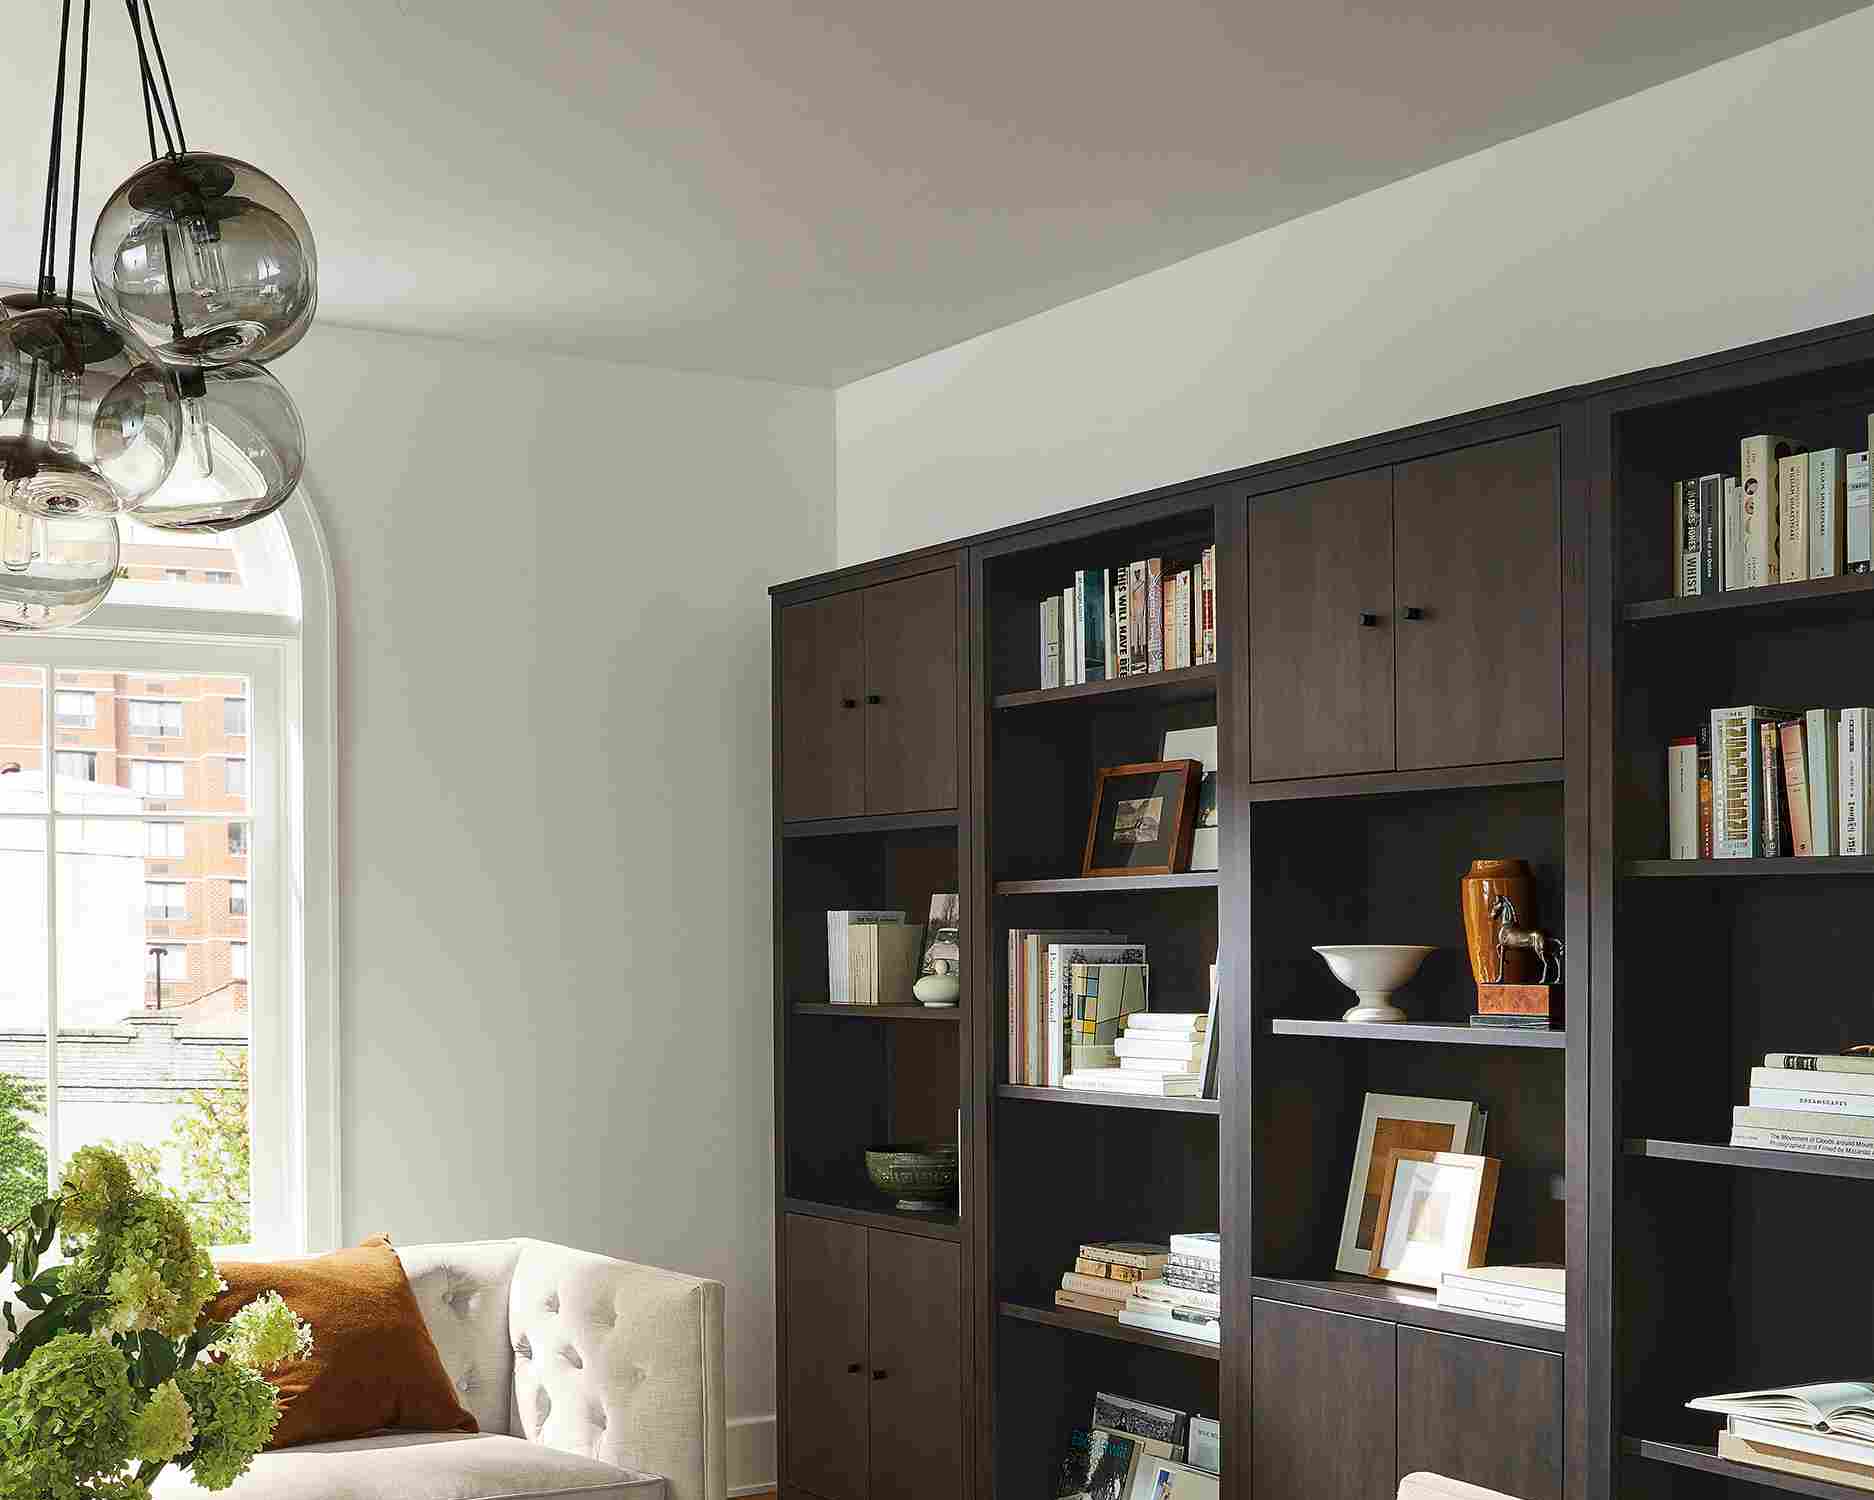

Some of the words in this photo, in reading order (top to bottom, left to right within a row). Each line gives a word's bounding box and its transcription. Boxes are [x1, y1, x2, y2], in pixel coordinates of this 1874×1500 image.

[1118, 567, 1127, 592] THIS
[1119, 595, 1128, 624] WILL
[1119, 626, 1128, 656] HAVE
[1799, 1097, 1848, 1107] DREAMSCAPES
